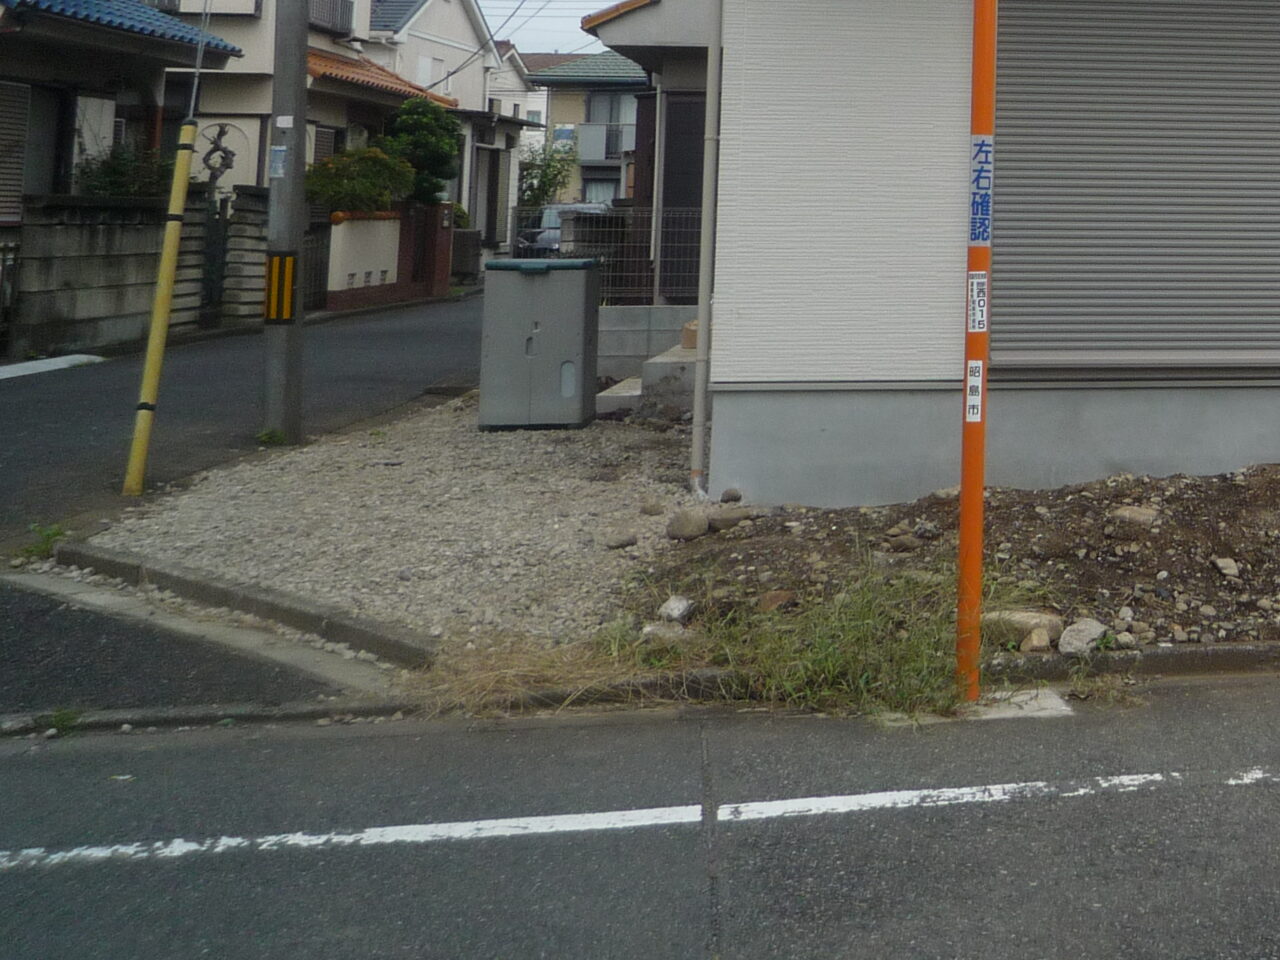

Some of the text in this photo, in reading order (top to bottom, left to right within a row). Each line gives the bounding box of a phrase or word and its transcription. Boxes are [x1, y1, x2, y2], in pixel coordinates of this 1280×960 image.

[970, 140, 993, 242] 左右確認
[967, 366, 981, 416] 昭島市
